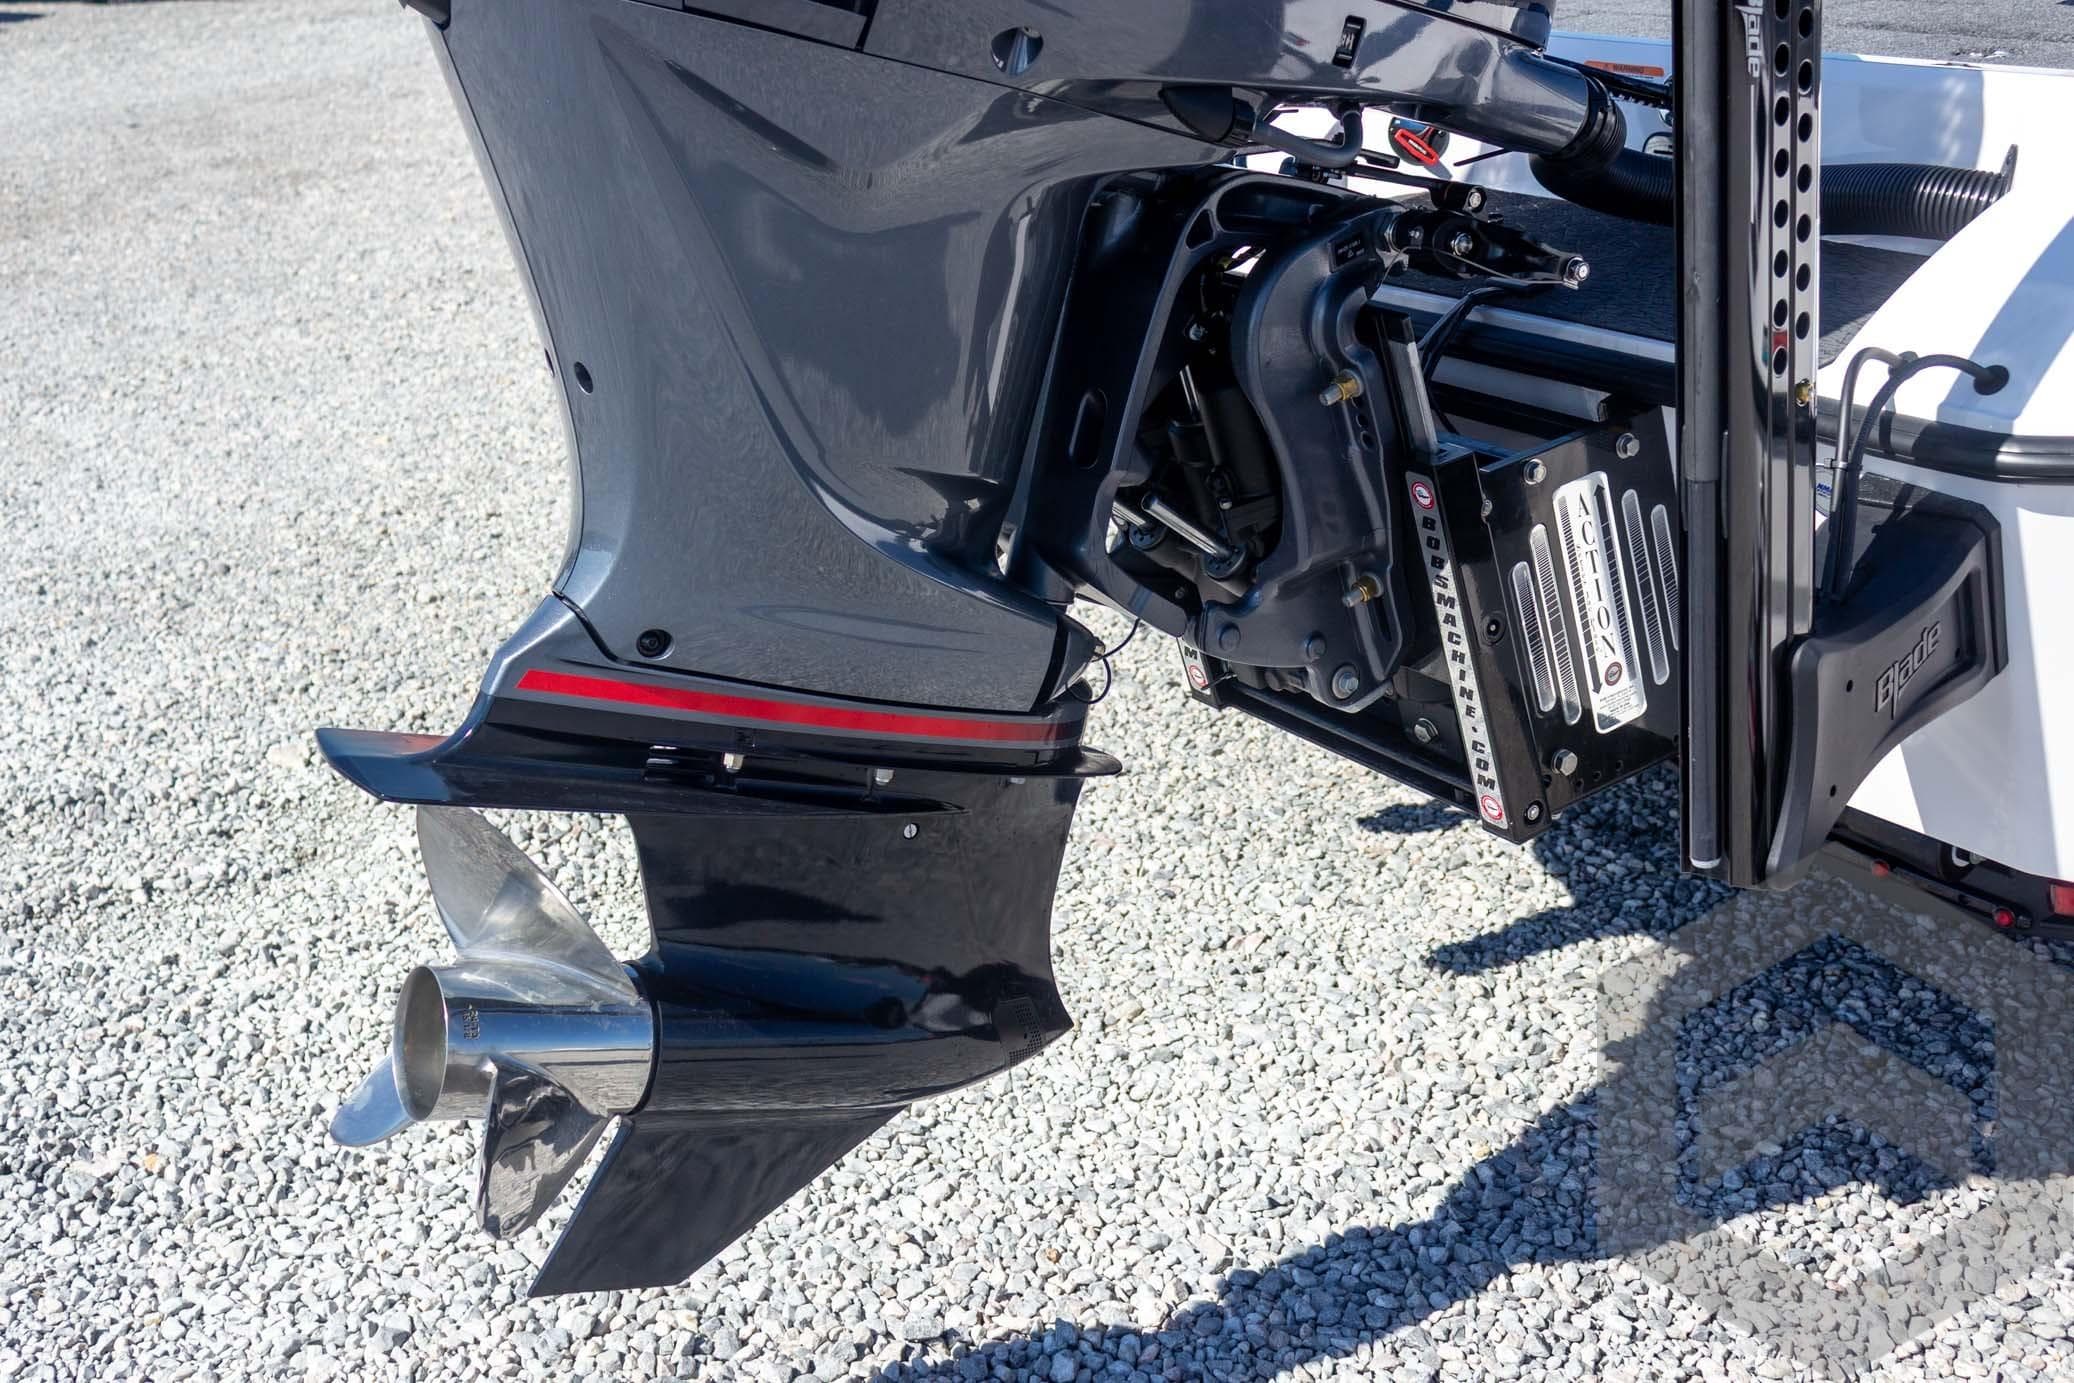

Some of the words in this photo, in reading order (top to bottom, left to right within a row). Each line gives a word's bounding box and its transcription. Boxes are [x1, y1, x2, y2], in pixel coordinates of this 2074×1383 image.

[1421, 515, 1496, 791] BOBSMACHINE.COM
[1576, 491, 1616, 658] ACTION
[1875, 621, 1942, 720] Blade
